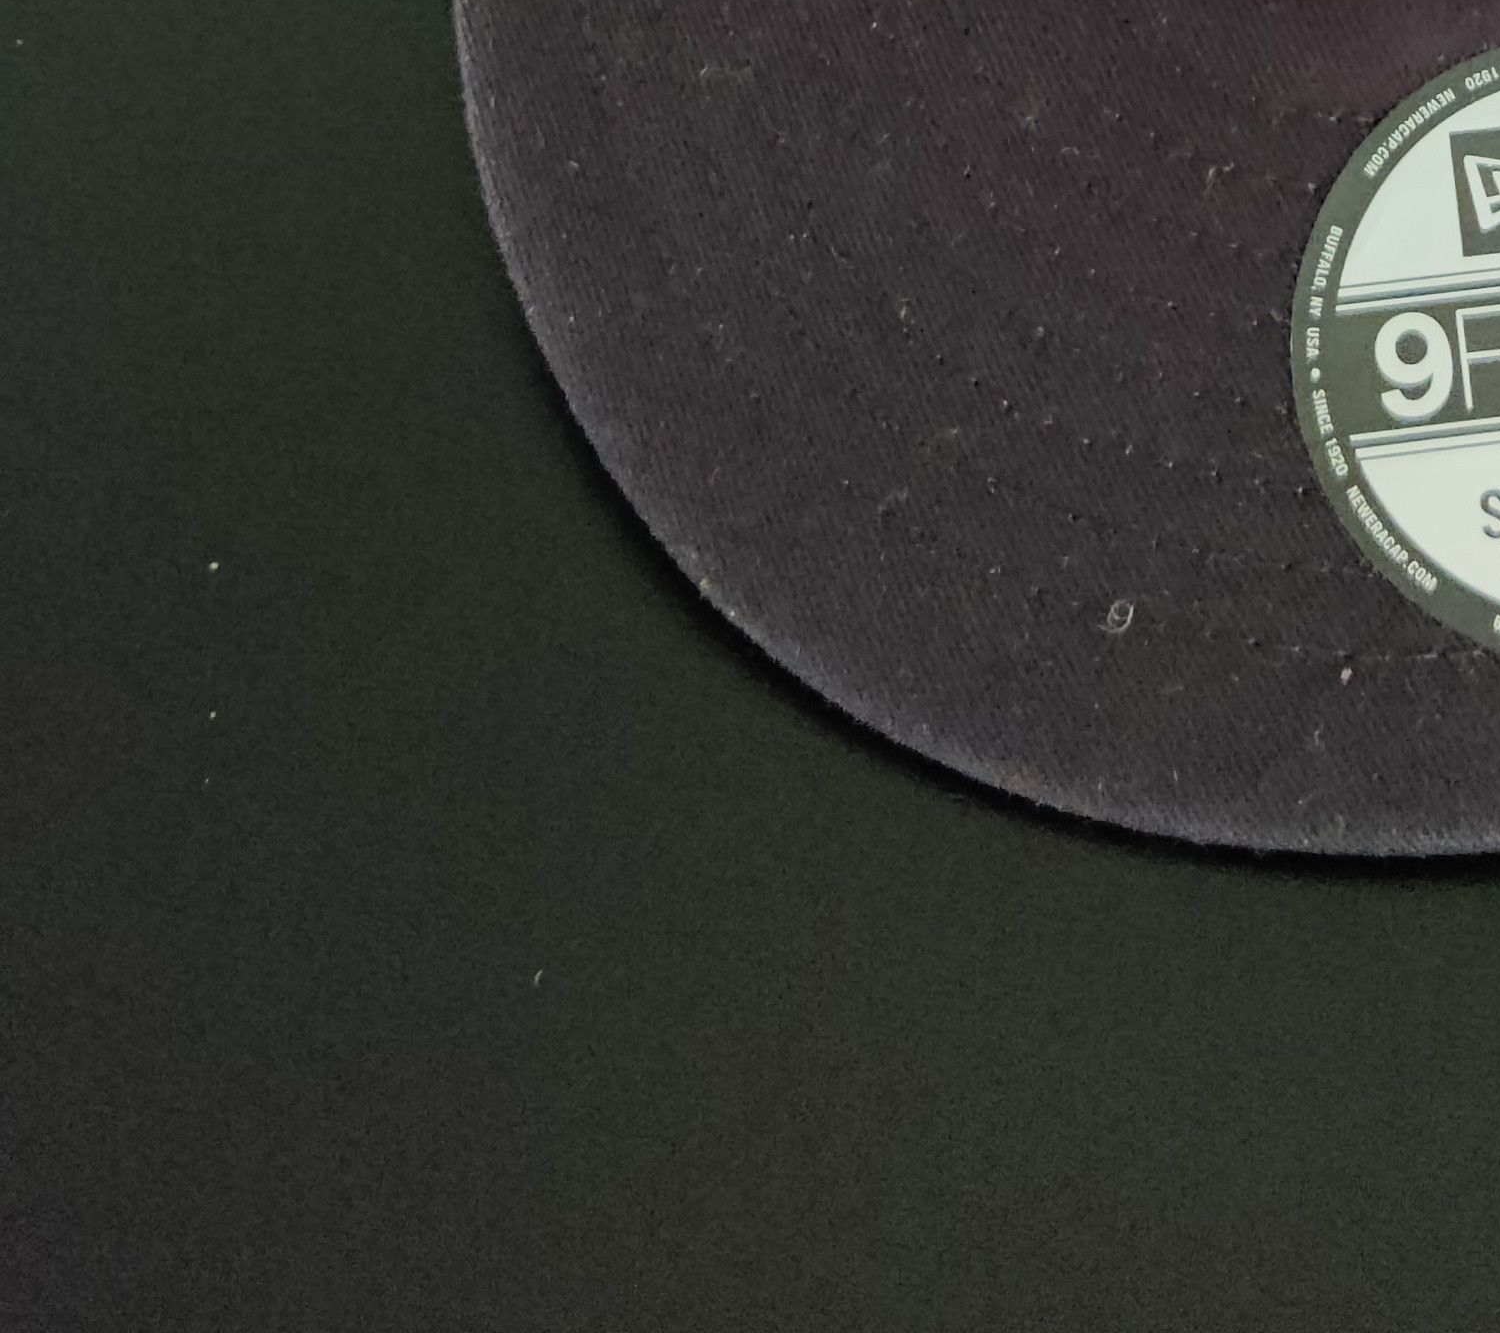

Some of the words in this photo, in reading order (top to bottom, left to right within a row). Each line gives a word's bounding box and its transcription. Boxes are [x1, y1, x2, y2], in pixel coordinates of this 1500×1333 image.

[1464, 66, 1499, 91] 1920
[1363, 87, 1456, 179] NEWERACAP.COM
[1306, 326, 1321, 360] USA
[1311, 388, 1334, 437] SINCE
[1325, 437, 1349, 478] 1920
[1346, 485, 1438, 595] NEWERACAP.COM
